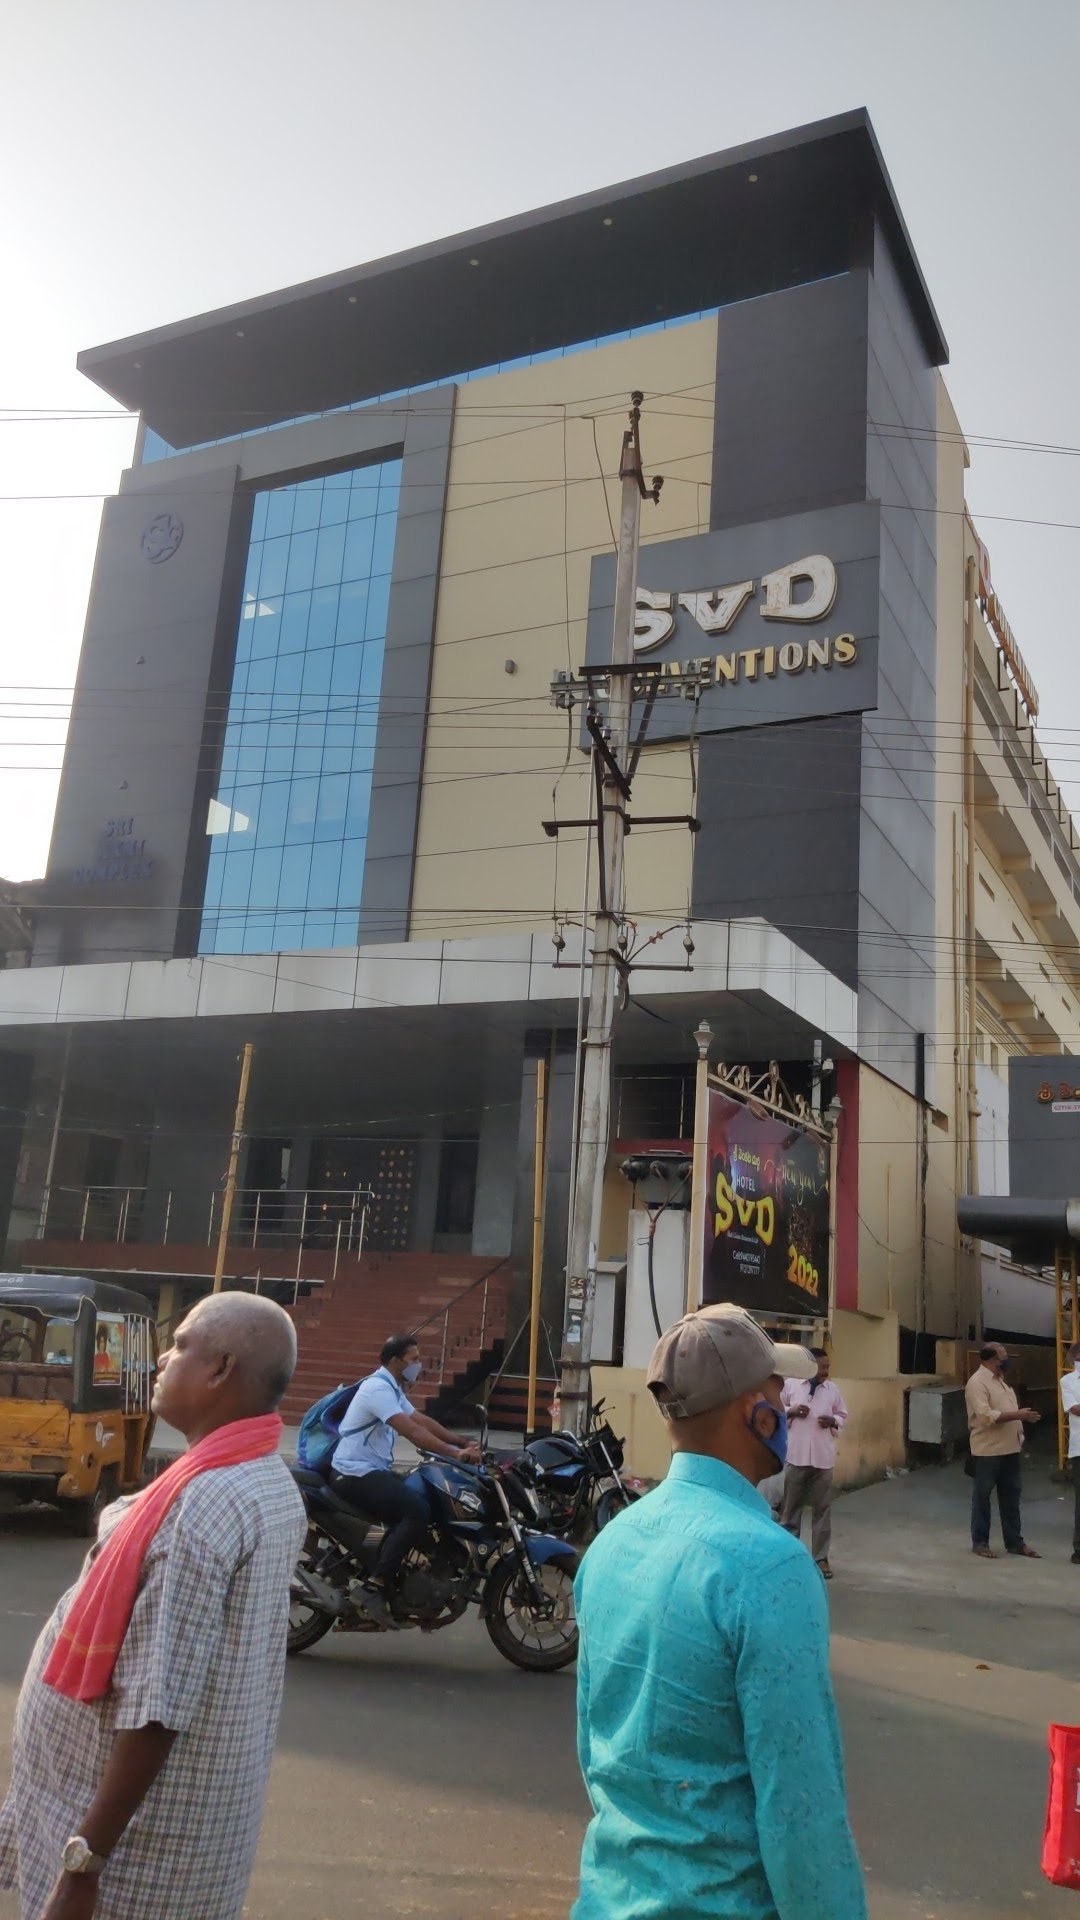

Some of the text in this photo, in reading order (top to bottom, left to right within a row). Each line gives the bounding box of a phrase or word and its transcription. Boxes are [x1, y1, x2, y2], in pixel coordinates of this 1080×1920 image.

[632, 554, 838, 654] SVD
[597, 632, 859, 698] VENTIONS
[715, 1171, 775, 1246] SVD
[736, 1173, 755, 1192] HOTEL
[787, 1244, 819, 1298] 2022
